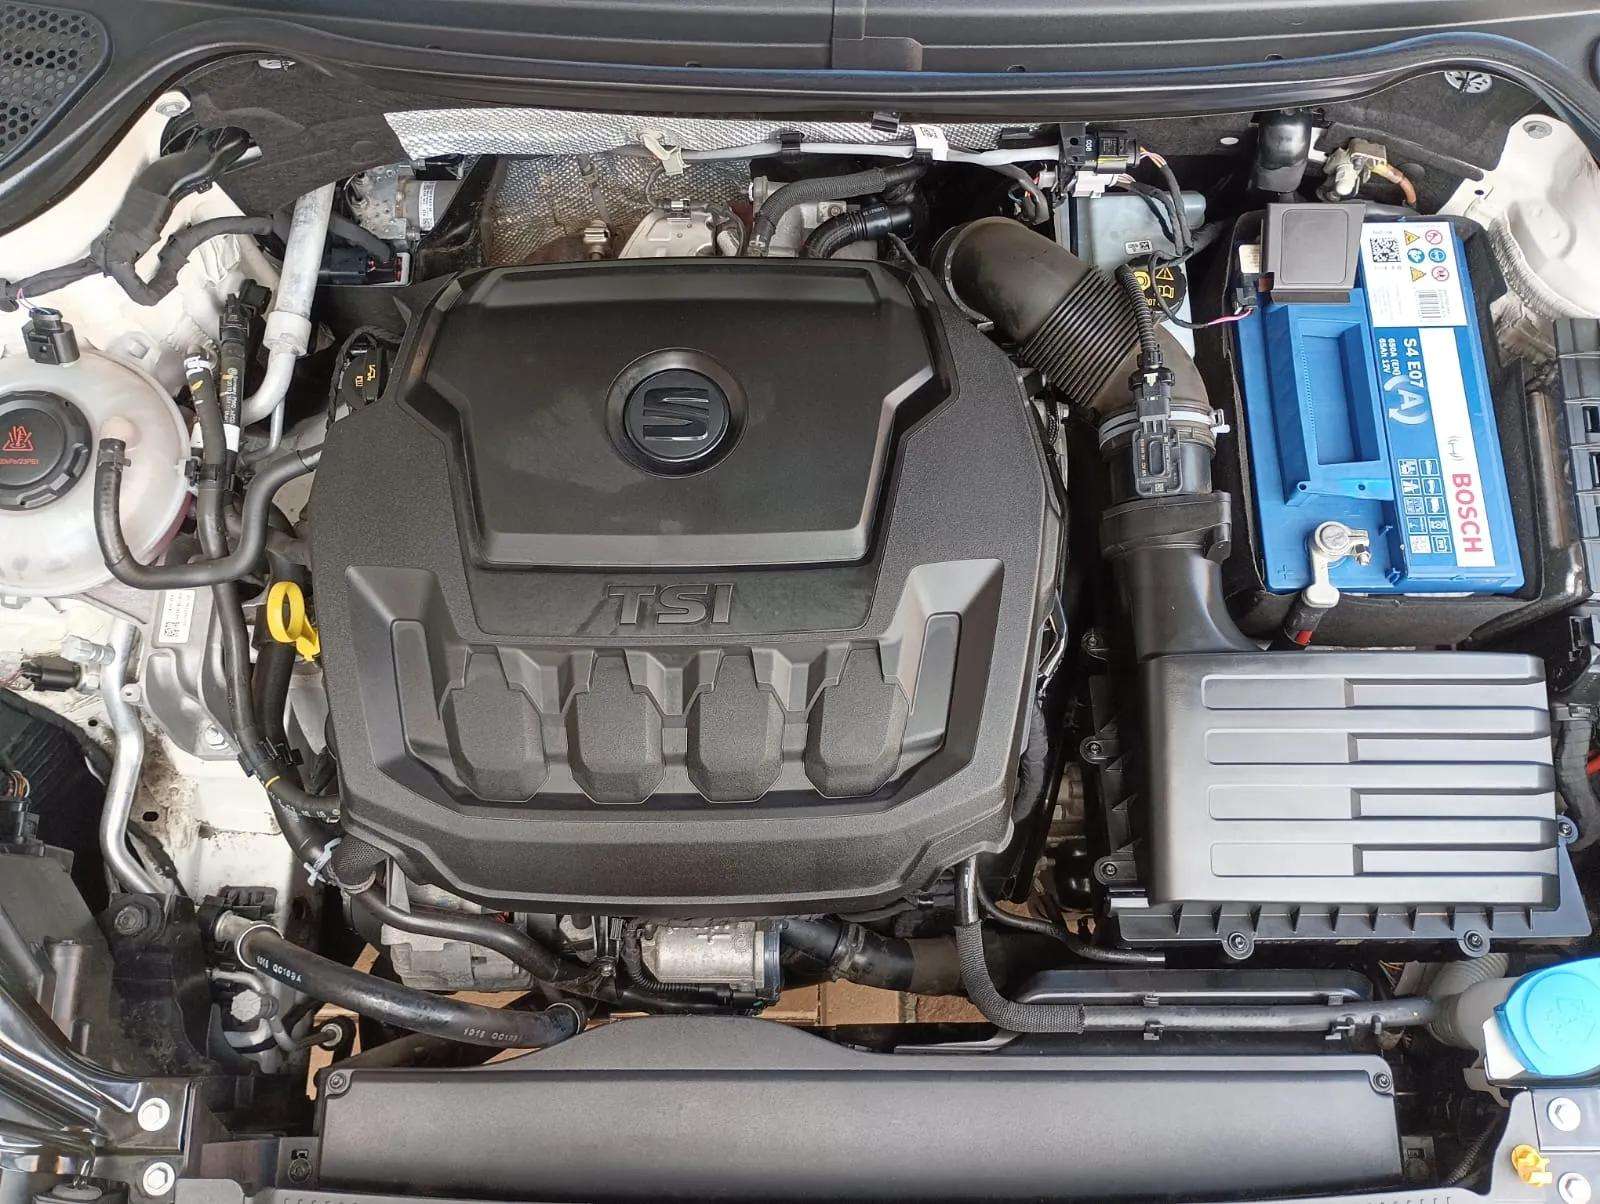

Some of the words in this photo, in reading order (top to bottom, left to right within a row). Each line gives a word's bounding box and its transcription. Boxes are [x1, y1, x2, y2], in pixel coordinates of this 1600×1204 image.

[1379, 337, 1388, 358] 65Ah
[1403, 338, 1419, 357] S4
[1382, 359, 1391, 374] 12V
[1408, 361, 1424, 389] E07
[1452, 473, 1484, 552] BOSCH
[607, 583, 734, 625] TSI
